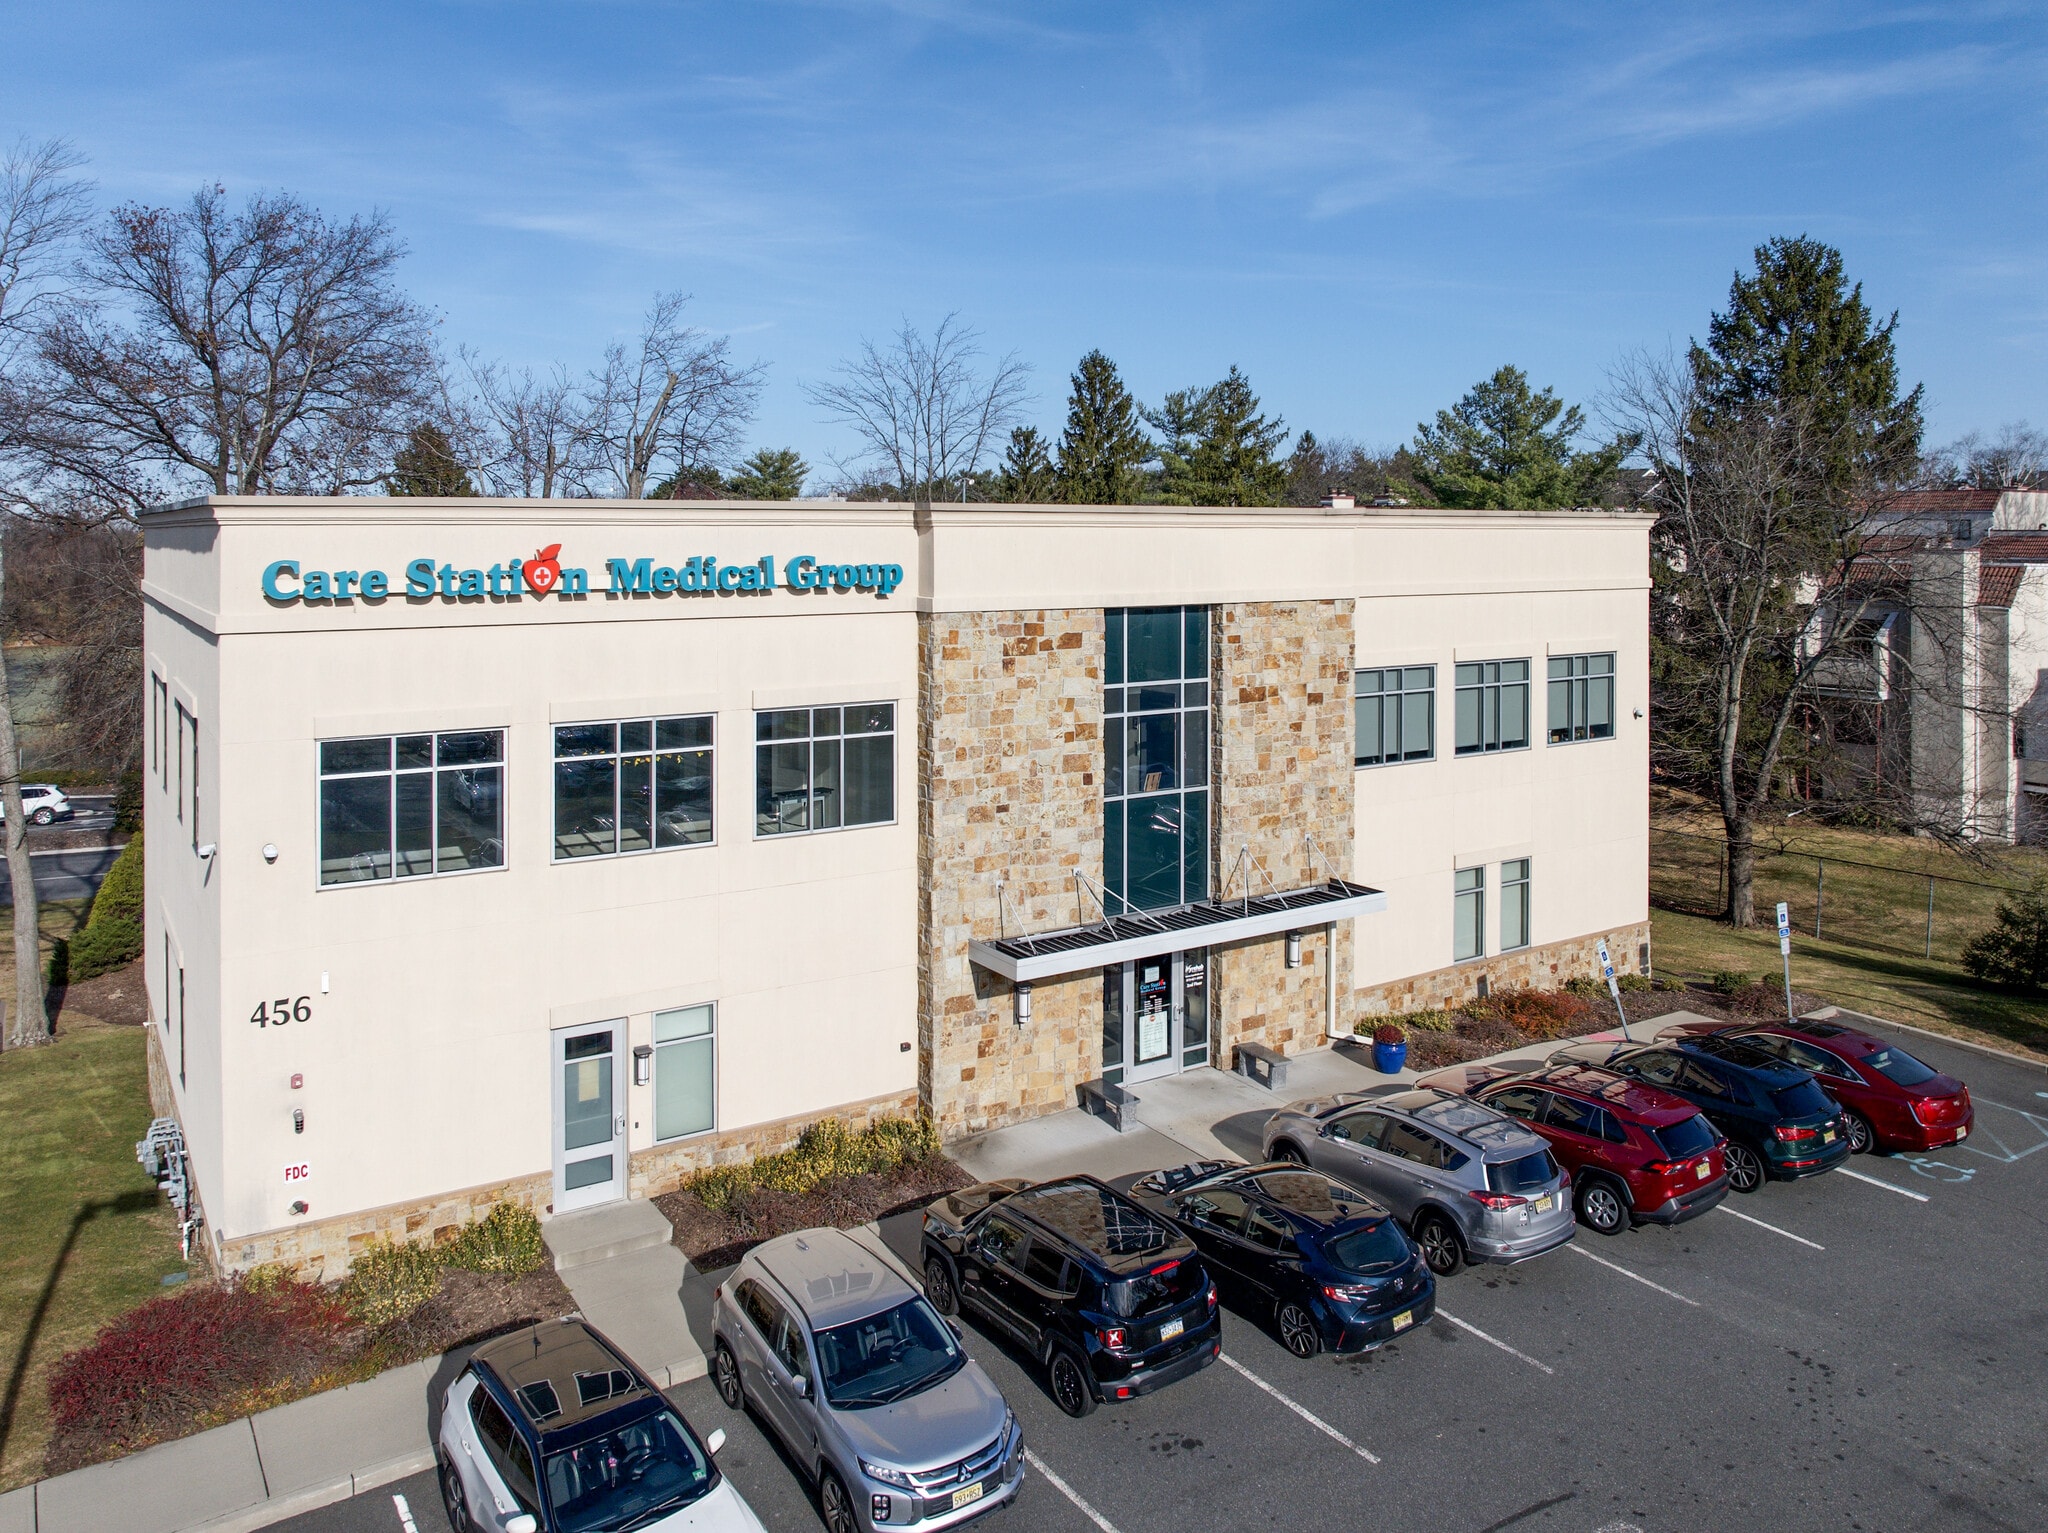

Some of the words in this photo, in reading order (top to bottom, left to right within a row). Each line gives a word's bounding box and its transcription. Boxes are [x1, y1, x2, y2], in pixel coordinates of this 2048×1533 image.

[263, 560, 388, 600] Care
[607, 556, 778, 594] Medical
[787, 555, 904, 598] Group
[250, 995, 312, 1028] 456
[285, 1164, 309, 1181] FDC
